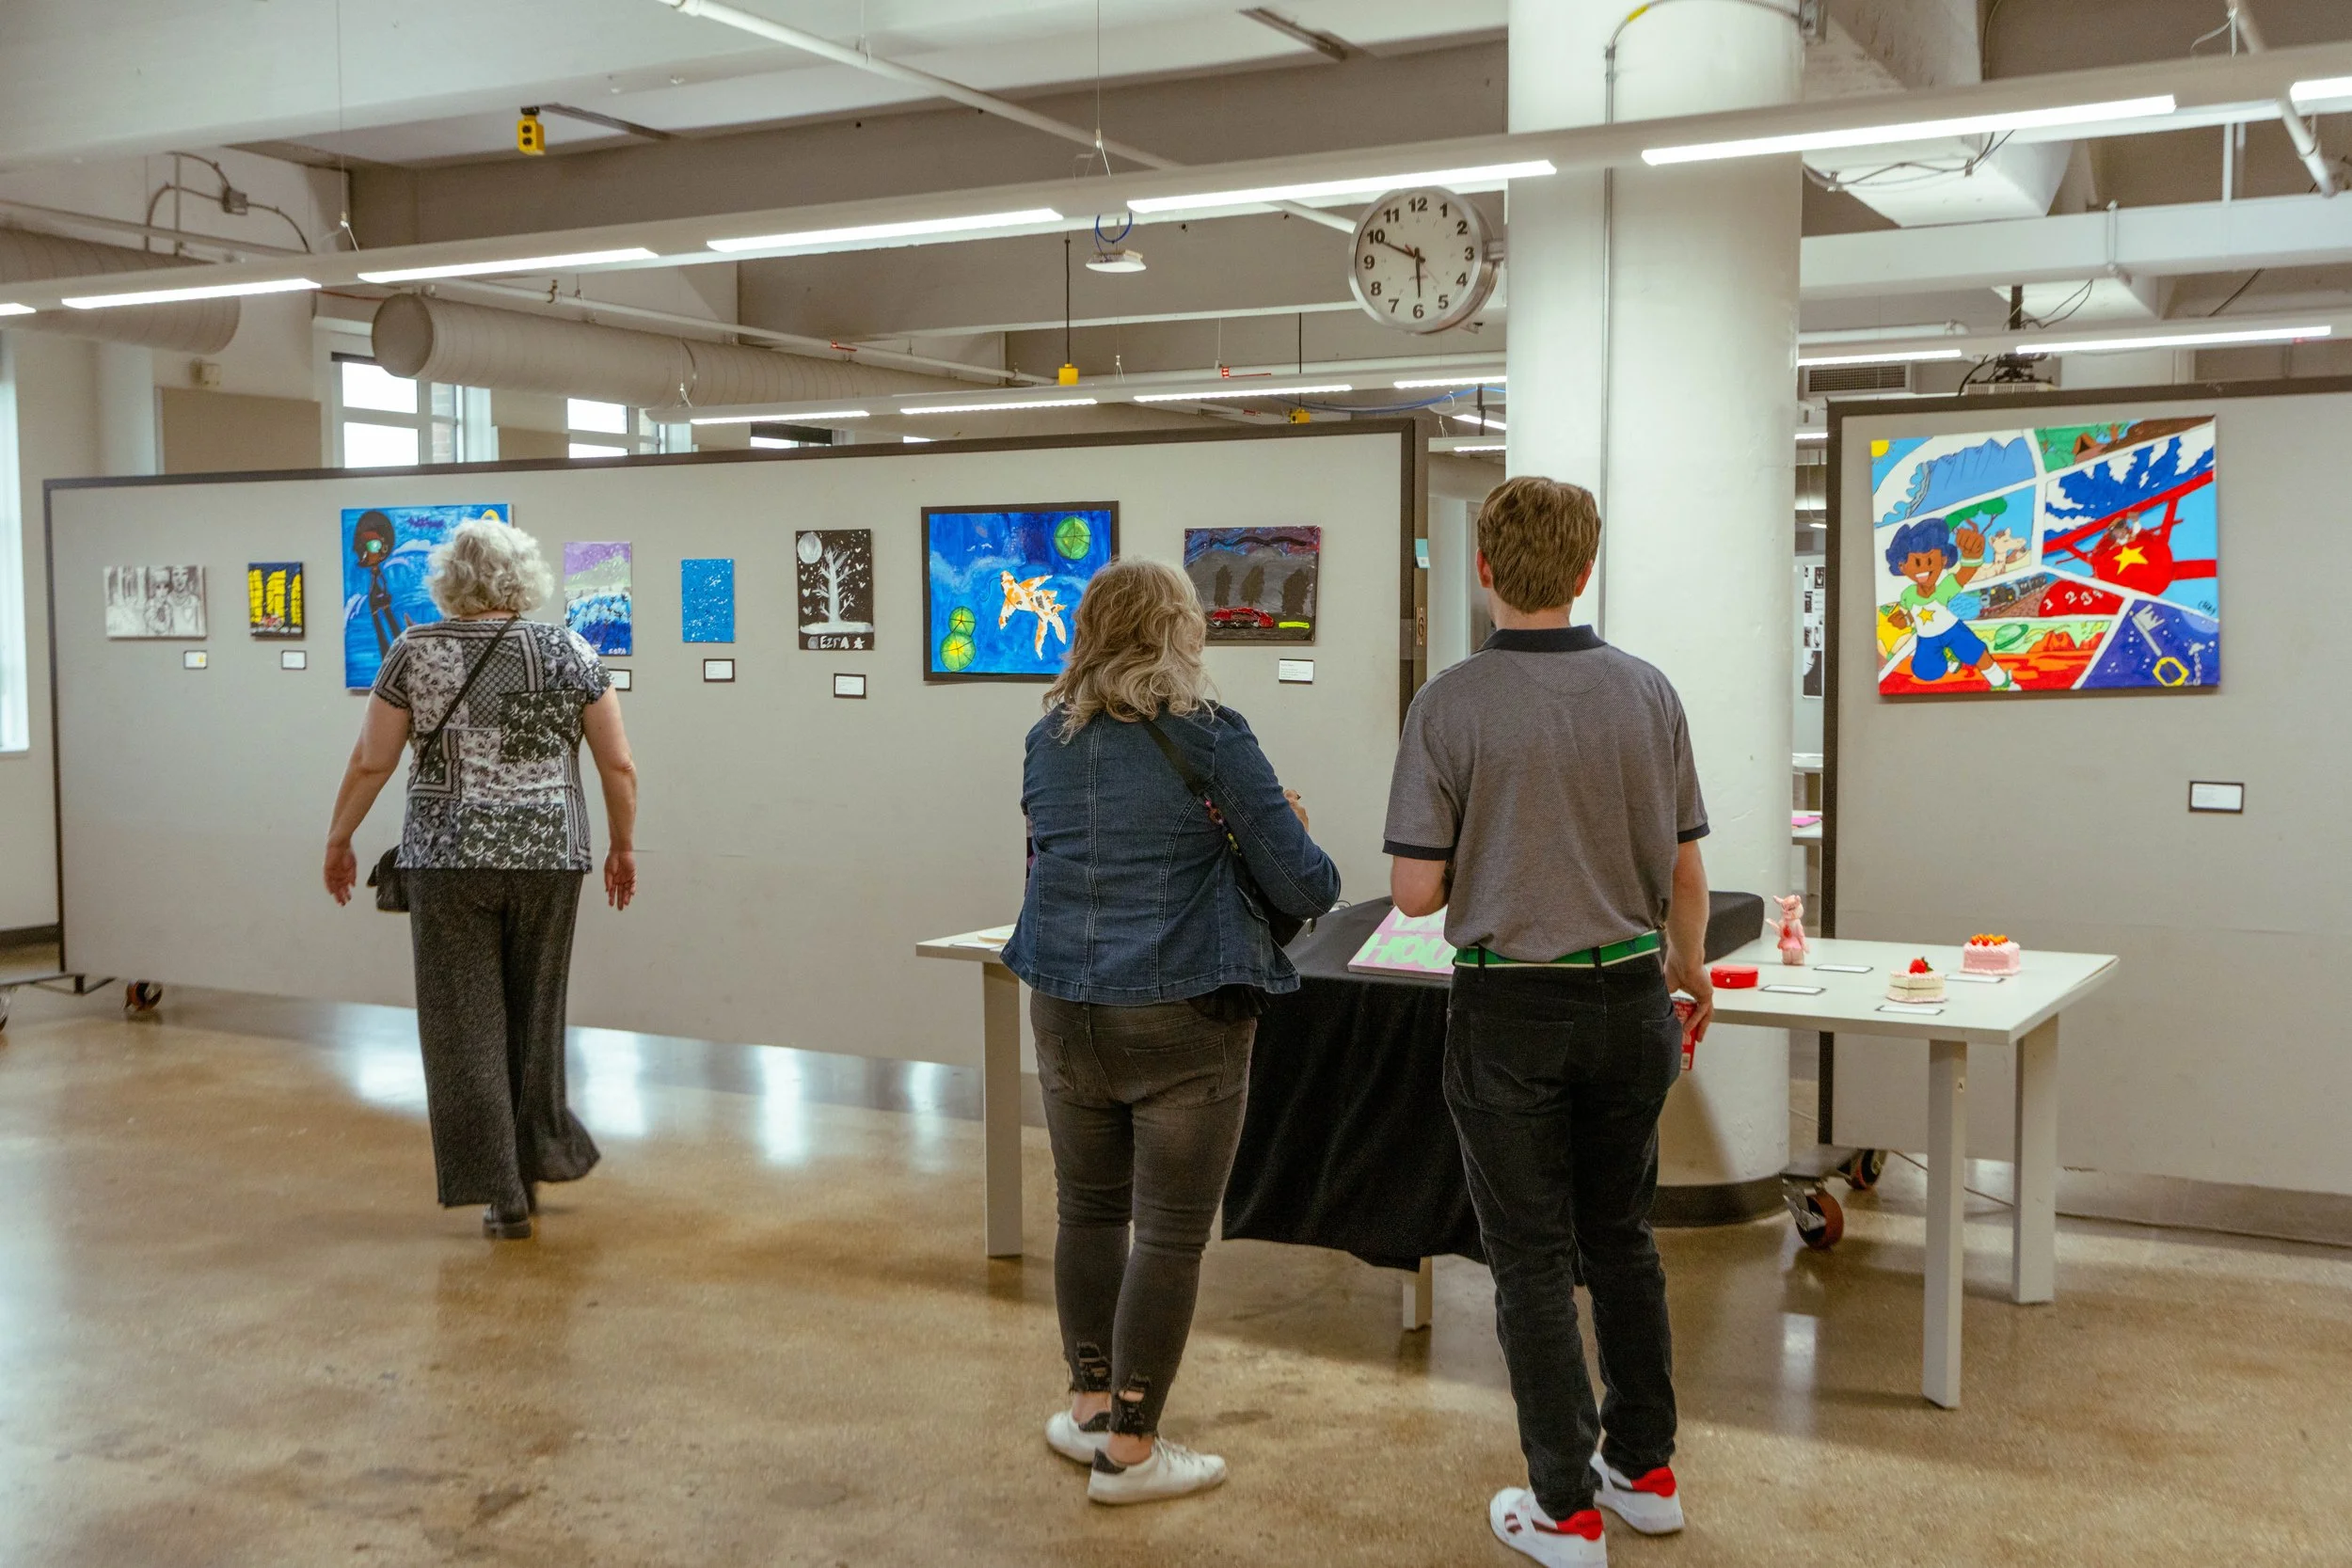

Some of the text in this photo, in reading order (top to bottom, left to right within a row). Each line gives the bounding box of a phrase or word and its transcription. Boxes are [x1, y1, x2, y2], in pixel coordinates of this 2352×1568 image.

[1408, 197, 1428, 213] 12
[1439, 203, 1448, 218] 1
[1383, 208, 1400, 223] 11
[1456, 220, 1468, 235] 2
[1366, 229, 1386, 245] 10
[1464, 246, 1474, 261] 3
[1363, 255, 1375, 270] 9
[1455, 272, 1468, 287] 4
[1370, 281, 1382, 296] 8
[1388, 299, 1400, 313] 7
[1438, 294, 1449, 309] 5
[1412, 304, 1424, 319] 6
[2042, 598, 2054, 610] 1
[2065, 591, 2077, 605] 2
[2080, 591, 2093, 606] 3
